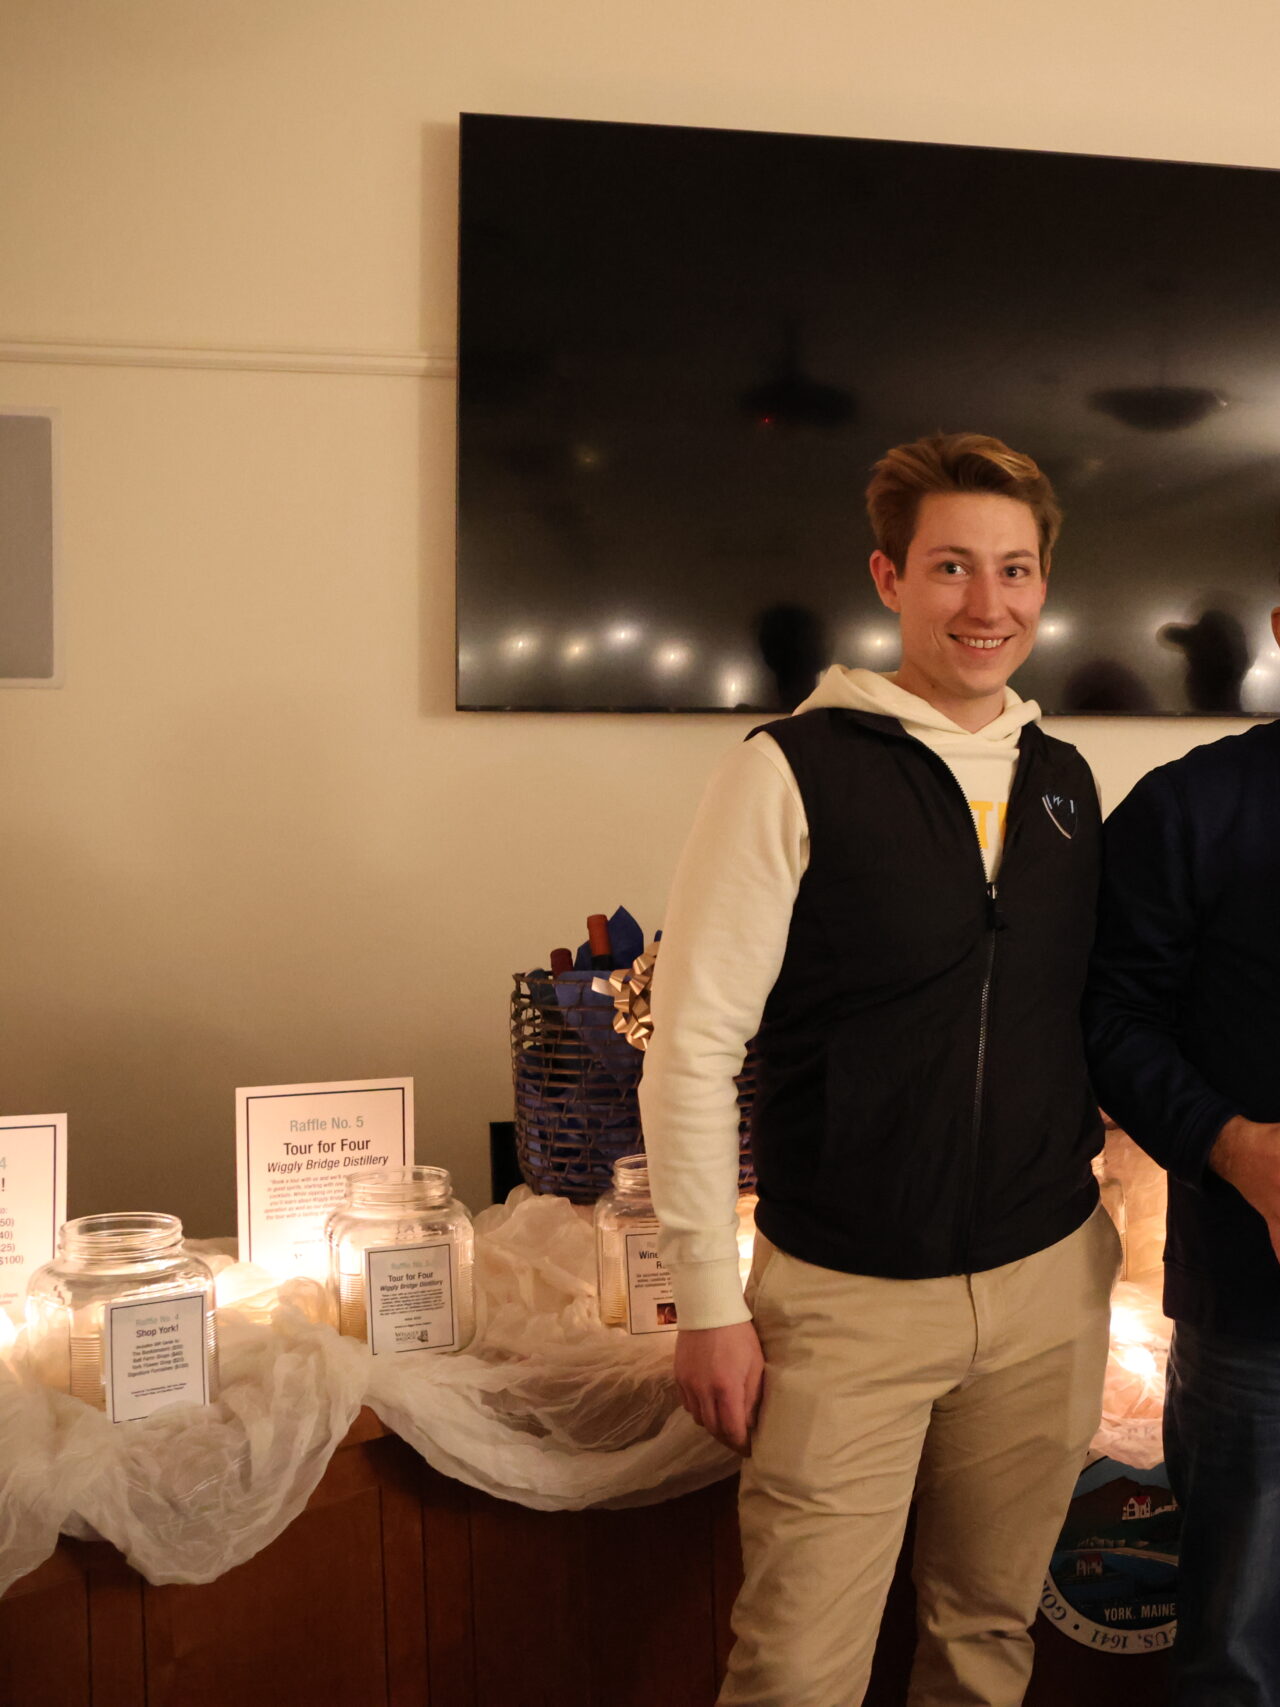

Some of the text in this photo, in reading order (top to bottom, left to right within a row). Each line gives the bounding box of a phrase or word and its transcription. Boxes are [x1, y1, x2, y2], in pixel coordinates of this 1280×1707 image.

[290, 1116, 364, 1132] Raffle No. 5
[284, 1138, 371, 1156] Tour for Four
[267, 1155, 389, 1174] Wiggly Bridge Distillery
[136, 1324, 179, 1338] Shop York!
[1141, 1603, 1176, 1618] MAINE
[1090, 1629, 1128, 1649] 1641
